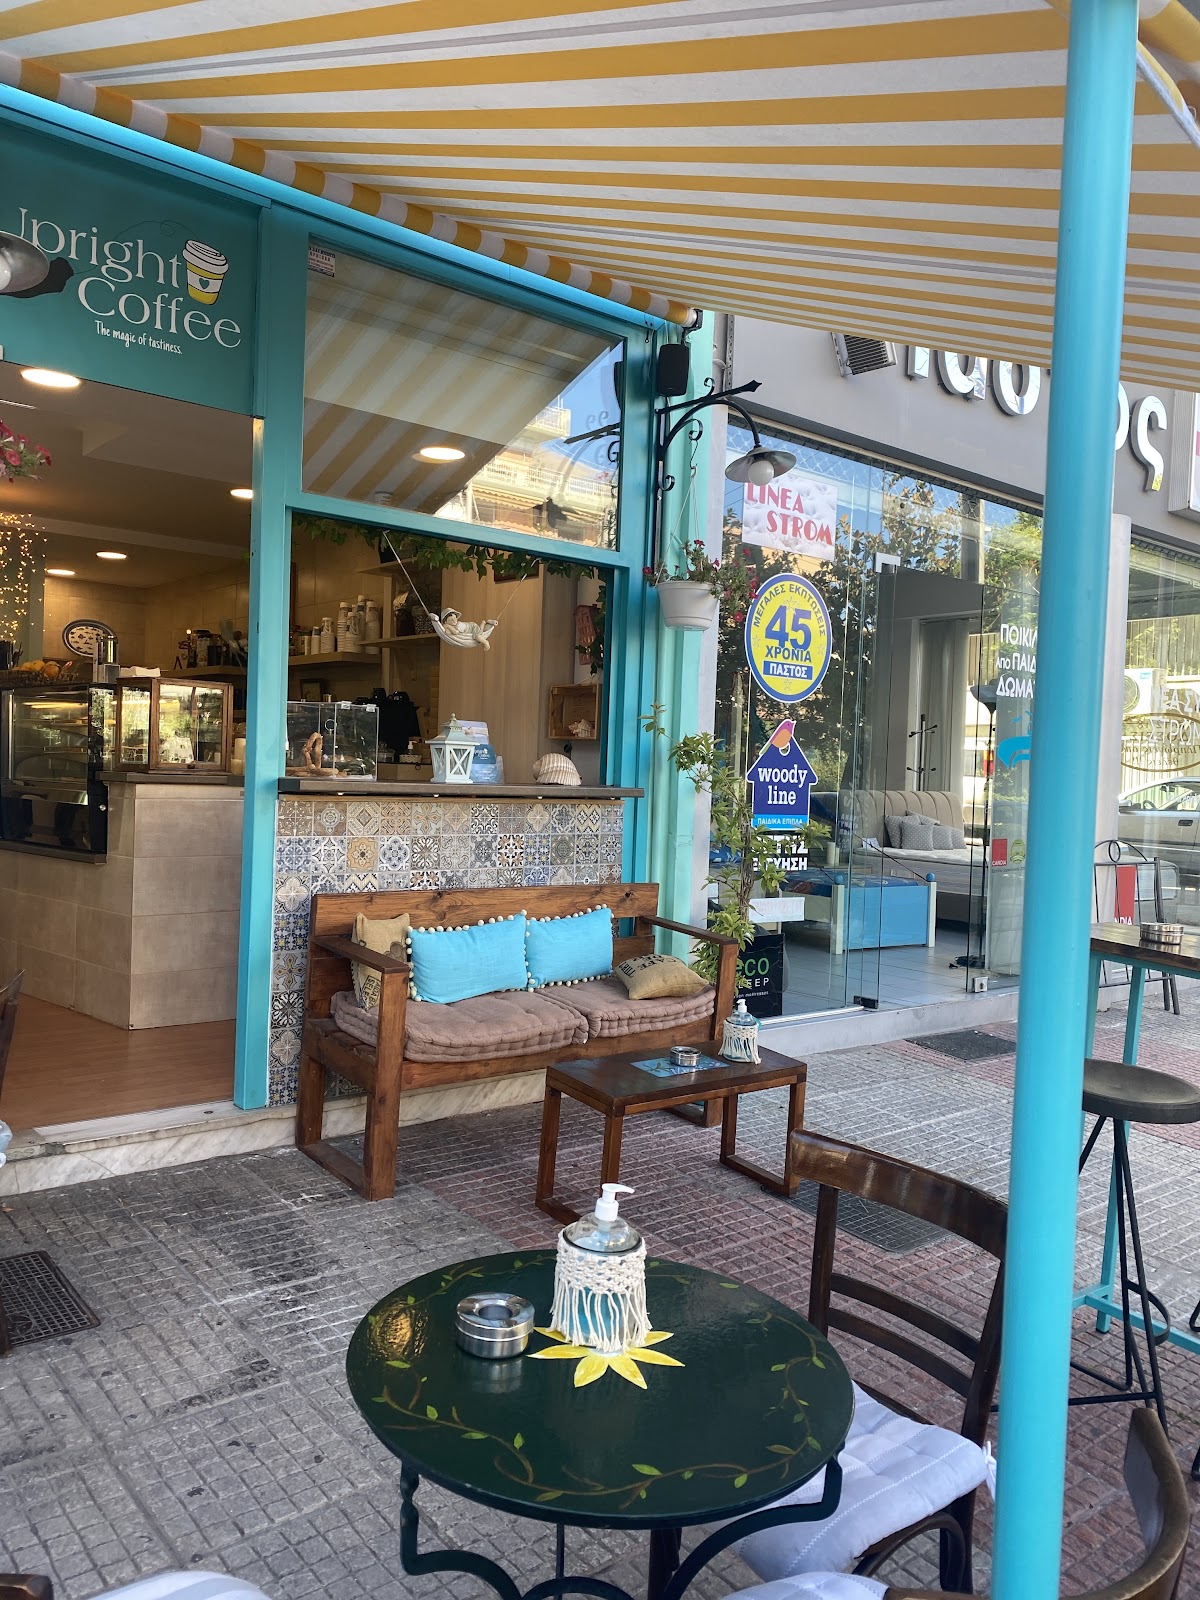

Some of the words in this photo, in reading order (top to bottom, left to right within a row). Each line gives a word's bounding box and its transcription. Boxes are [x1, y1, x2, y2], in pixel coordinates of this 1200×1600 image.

[77, 277, 242, 349] Coffee
[94, 320, 111, 337] The
[112, 329, 137, 348] magic
[138, 332, 148, 346] of
[148, 336, 183, 355] tastiness.
[747, 482, 805, 514] LINEA
[766, 510, 833, 546] STROM
[753, 583, 787, 628] ΜΕΓΑΛΕΣ
[788, 583, 827, 637] ΕΚΠΤΩΣΕΙΣ
[765, 605, 812, 652] 45
[765, 645, 812, 663] ΧΡΟΝΙΑ
[769, 662, 808, 678] ΠΑΣΤΟΣ
[996, 676, 1036, 699] ΔΩΜΑ
[757, 764, 808, 789] woody
[767, 785, 797, 806] line
[757, 817, 781, 825] ΠΑΙΔΙΚΑ
[782, 818, 803, 826] ΕΠΙΠΛΑ
[752, 857, 808, 872] ΕΓΥΗΣΗ
